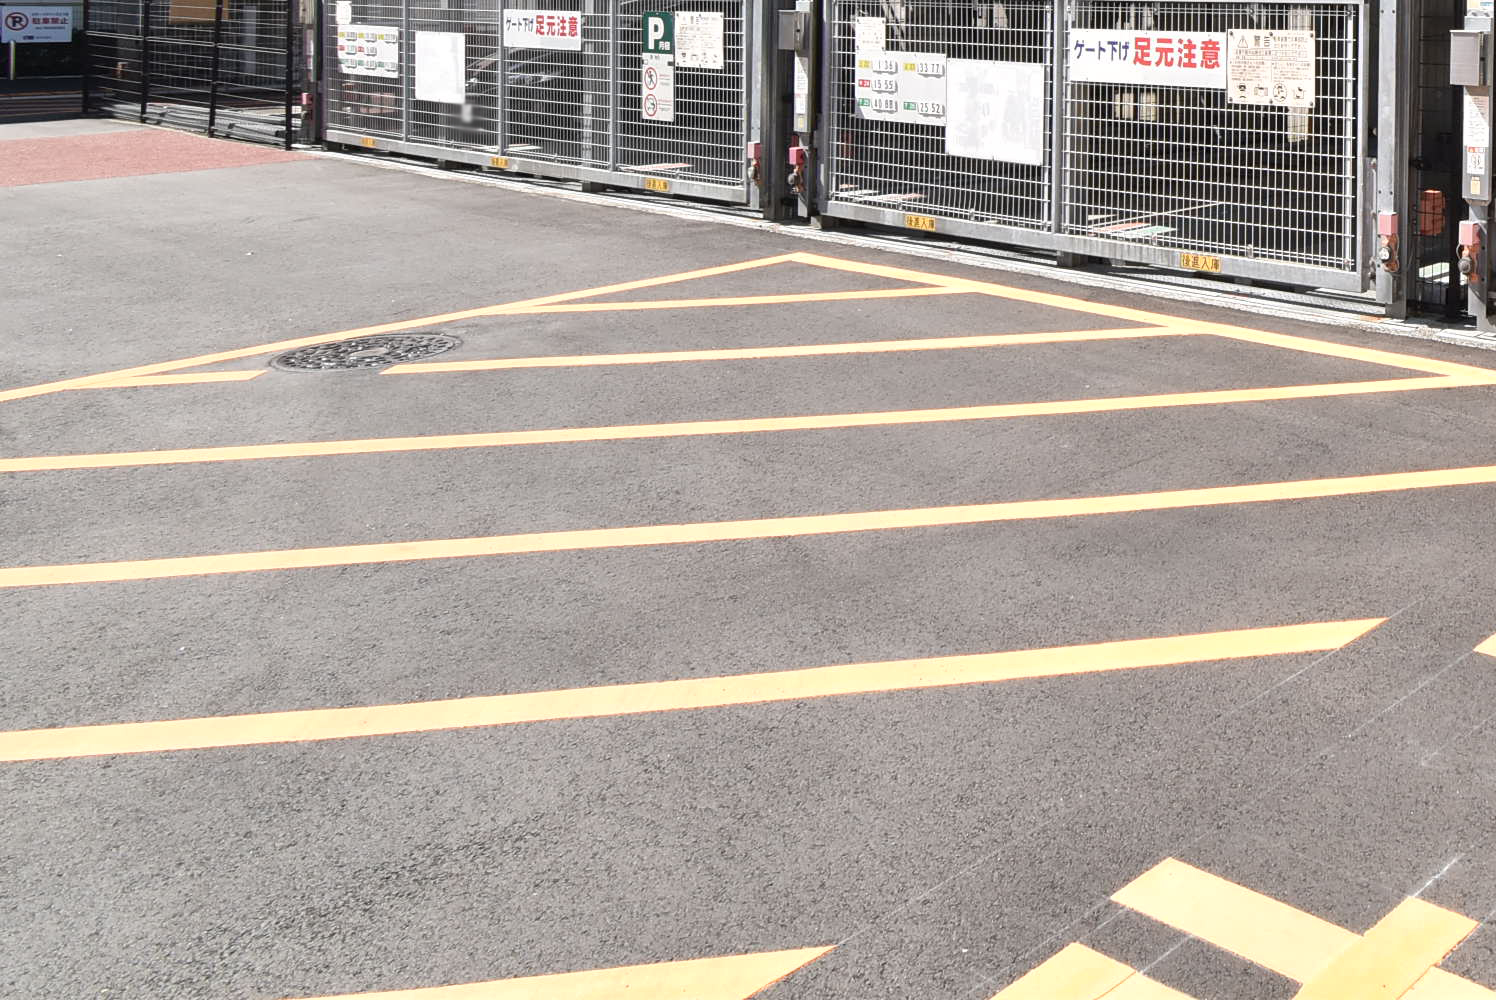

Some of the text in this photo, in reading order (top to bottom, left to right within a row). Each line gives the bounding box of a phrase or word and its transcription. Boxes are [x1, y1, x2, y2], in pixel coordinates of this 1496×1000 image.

[505, 15, 578, 37] ゲート下げ 足元注意
[648, 16, 664, 50] P
[1073, 39, 1130, 61] ゲート下げ
[1132, 36, 1221, 69] 足元注意
